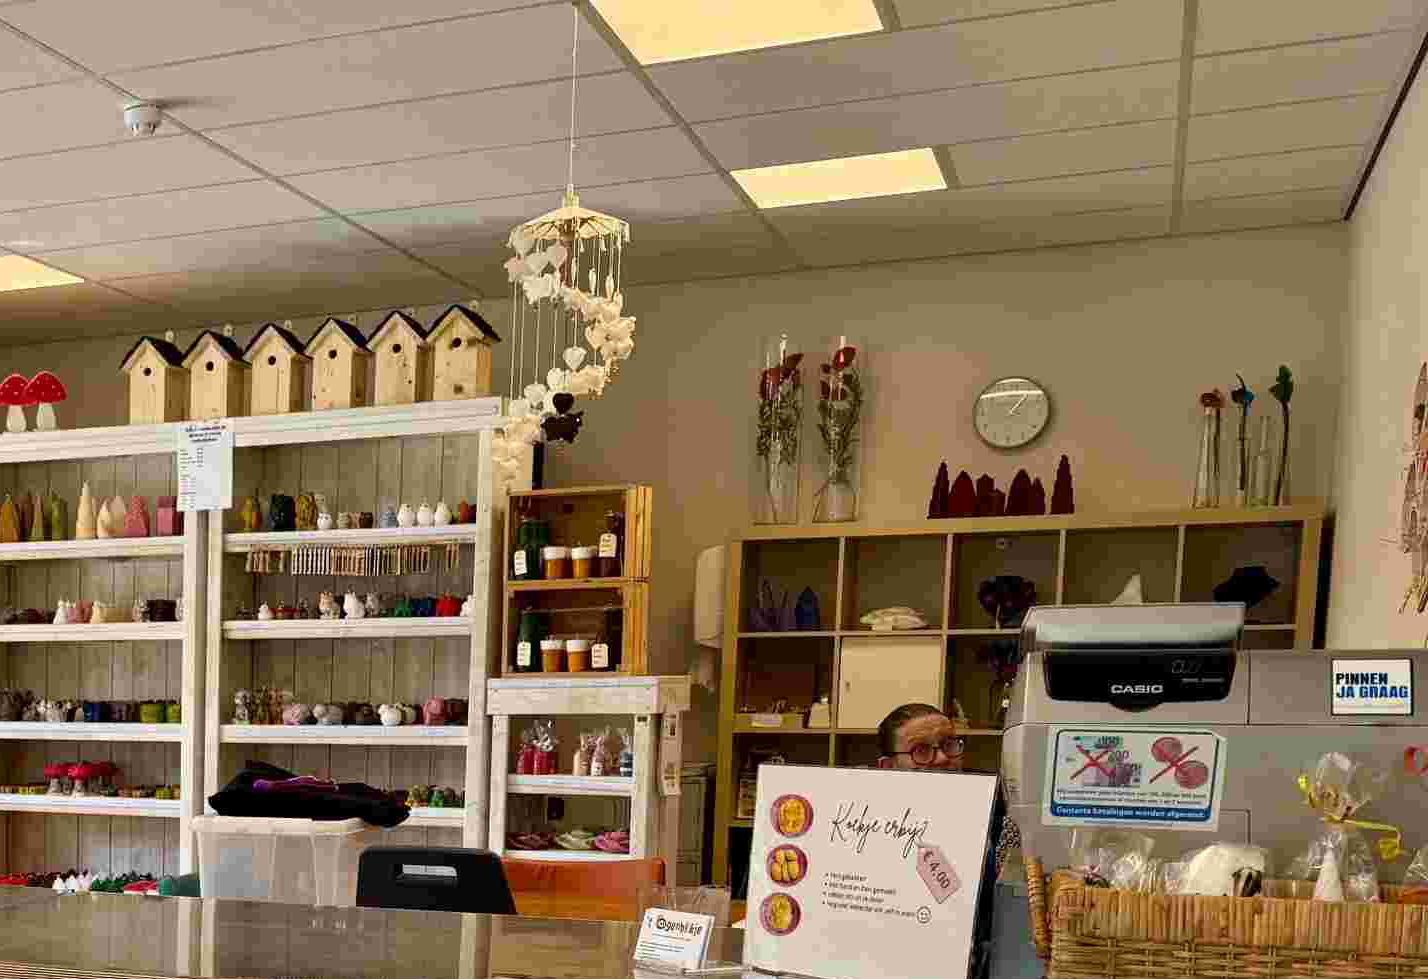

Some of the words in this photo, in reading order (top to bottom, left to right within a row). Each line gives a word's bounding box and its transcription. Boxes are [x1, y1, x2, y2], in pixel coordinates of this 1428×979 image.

[1335, 672, 1388, 685] PINNEN
[1110, 684, 1164, 694] CASIO
[1335, 685, 1355, 698] JA
[1358, 686, 1409, 699] GRAAG
